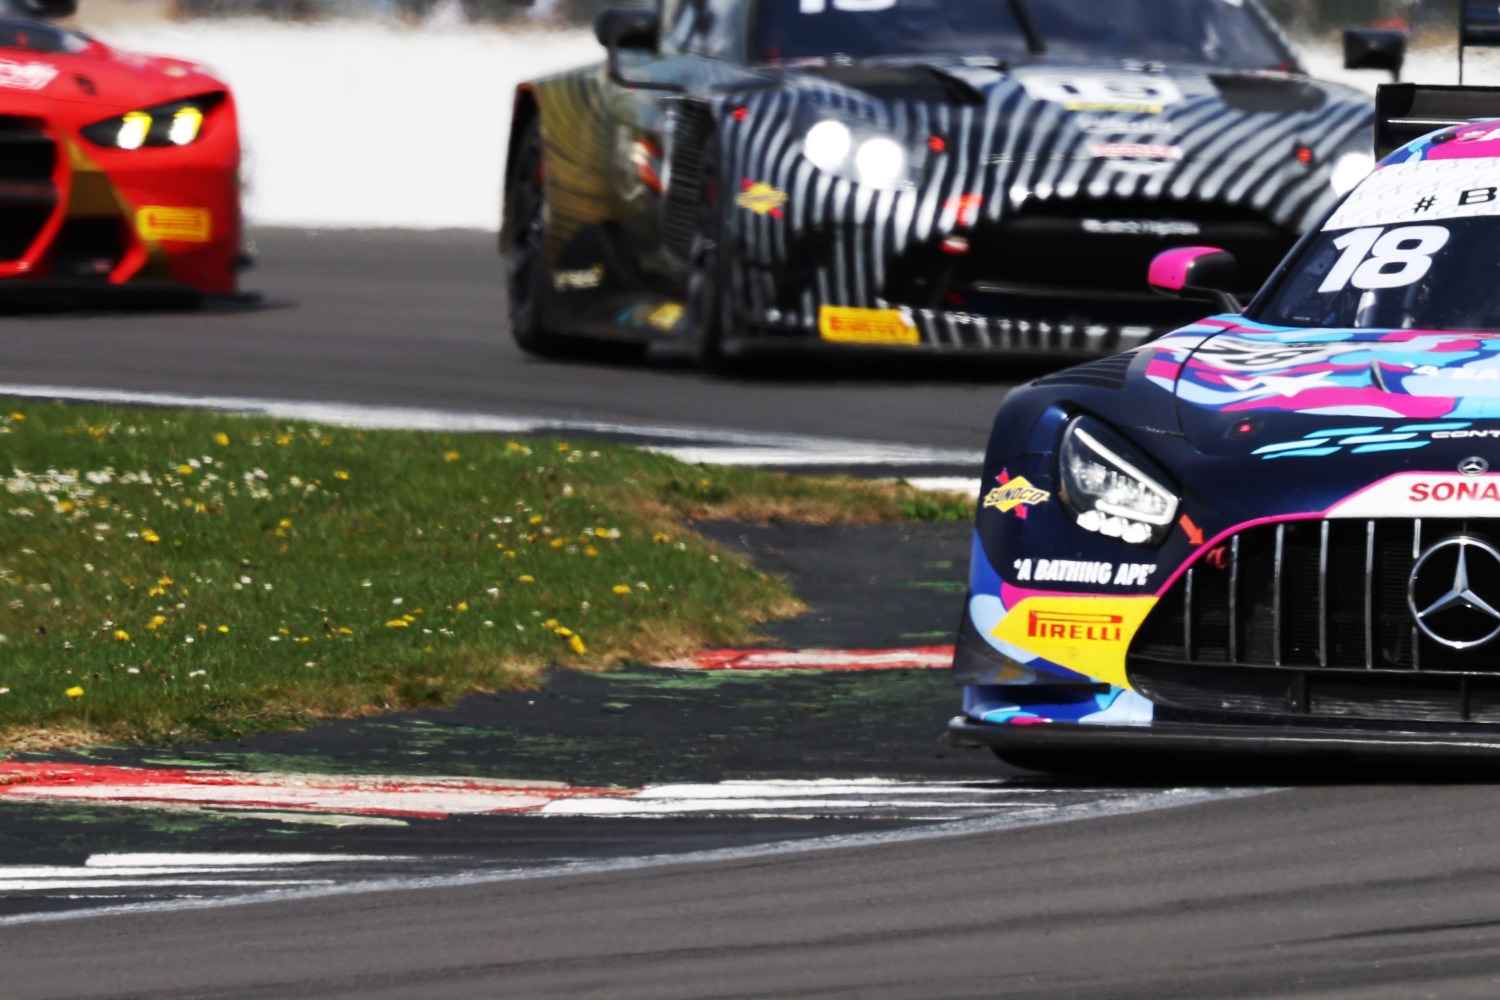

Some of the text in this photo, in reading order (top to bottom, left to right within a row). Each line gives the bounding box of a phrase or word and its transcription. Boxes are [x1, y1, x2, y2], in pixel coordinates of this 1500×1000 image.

[1317, 225, 1450, 293] 18
[1033, 558, 1112, 584] BATHING
[1028, 610, 1123, 641] PIRELLI
